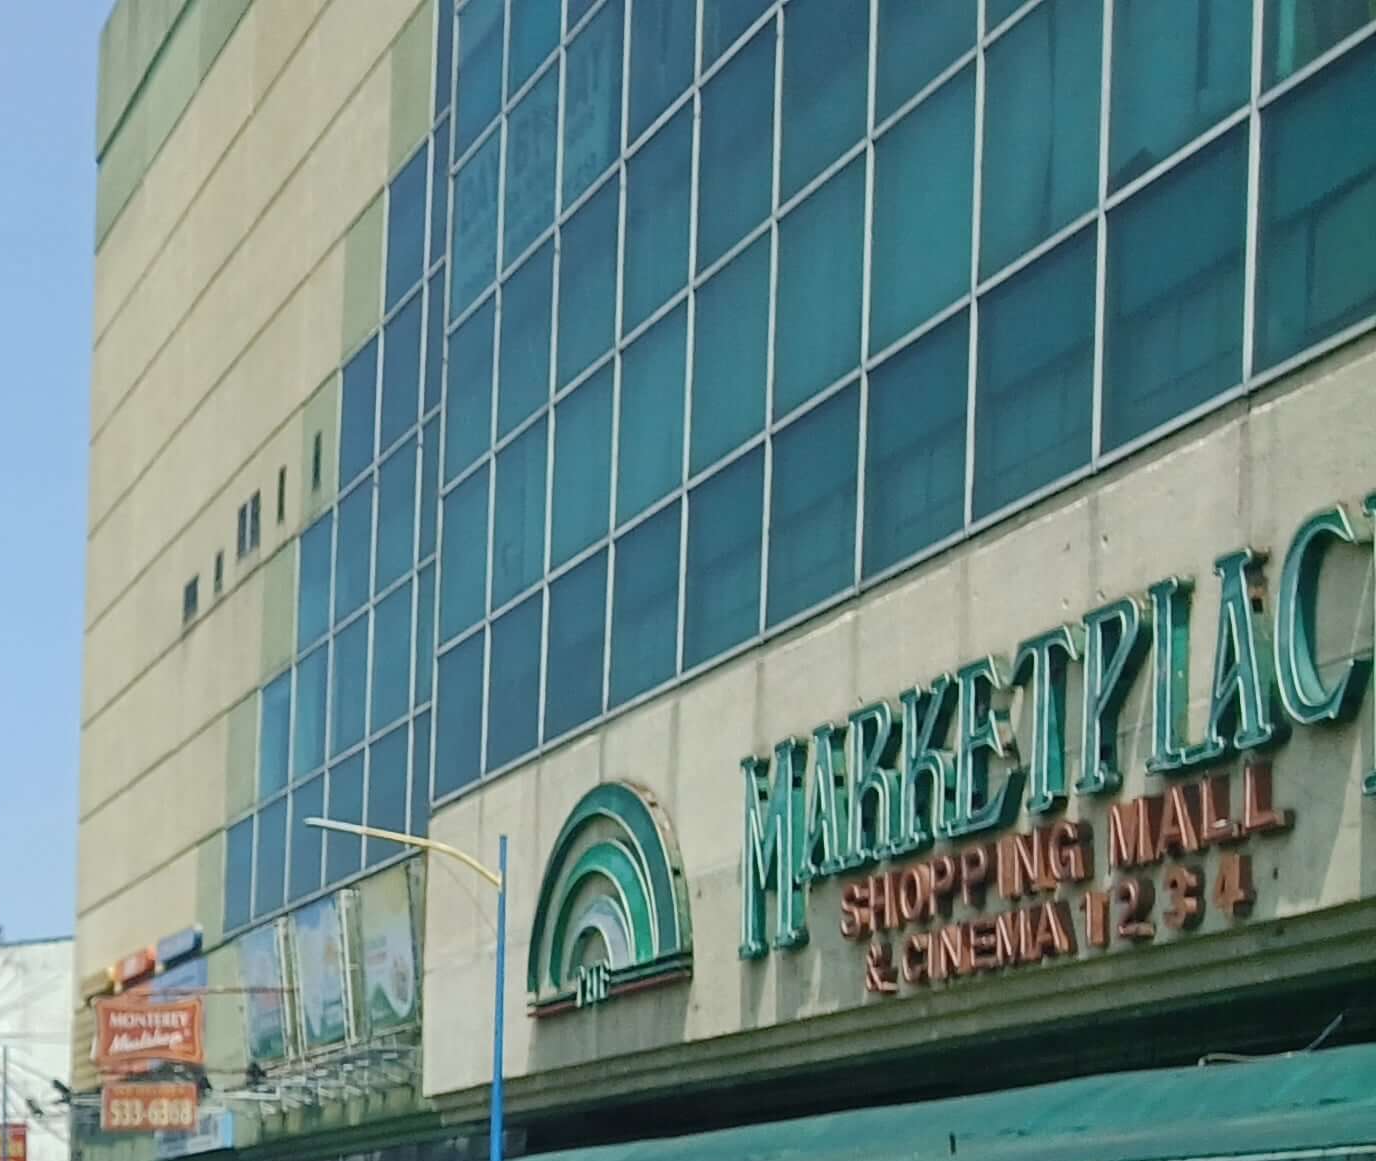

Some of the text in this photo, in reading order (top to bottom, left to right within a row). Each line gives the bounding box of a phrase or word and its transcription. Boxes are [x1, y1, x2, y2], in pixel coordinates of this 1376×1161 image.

[738, 490, 1376, 960] MARKETPLAC
[840, 760, 1288, 940] SHOPPING MALL
[902, 900, 1073, 982] CINEMA
[109, 1011, 189, 1028] MONTEREY
